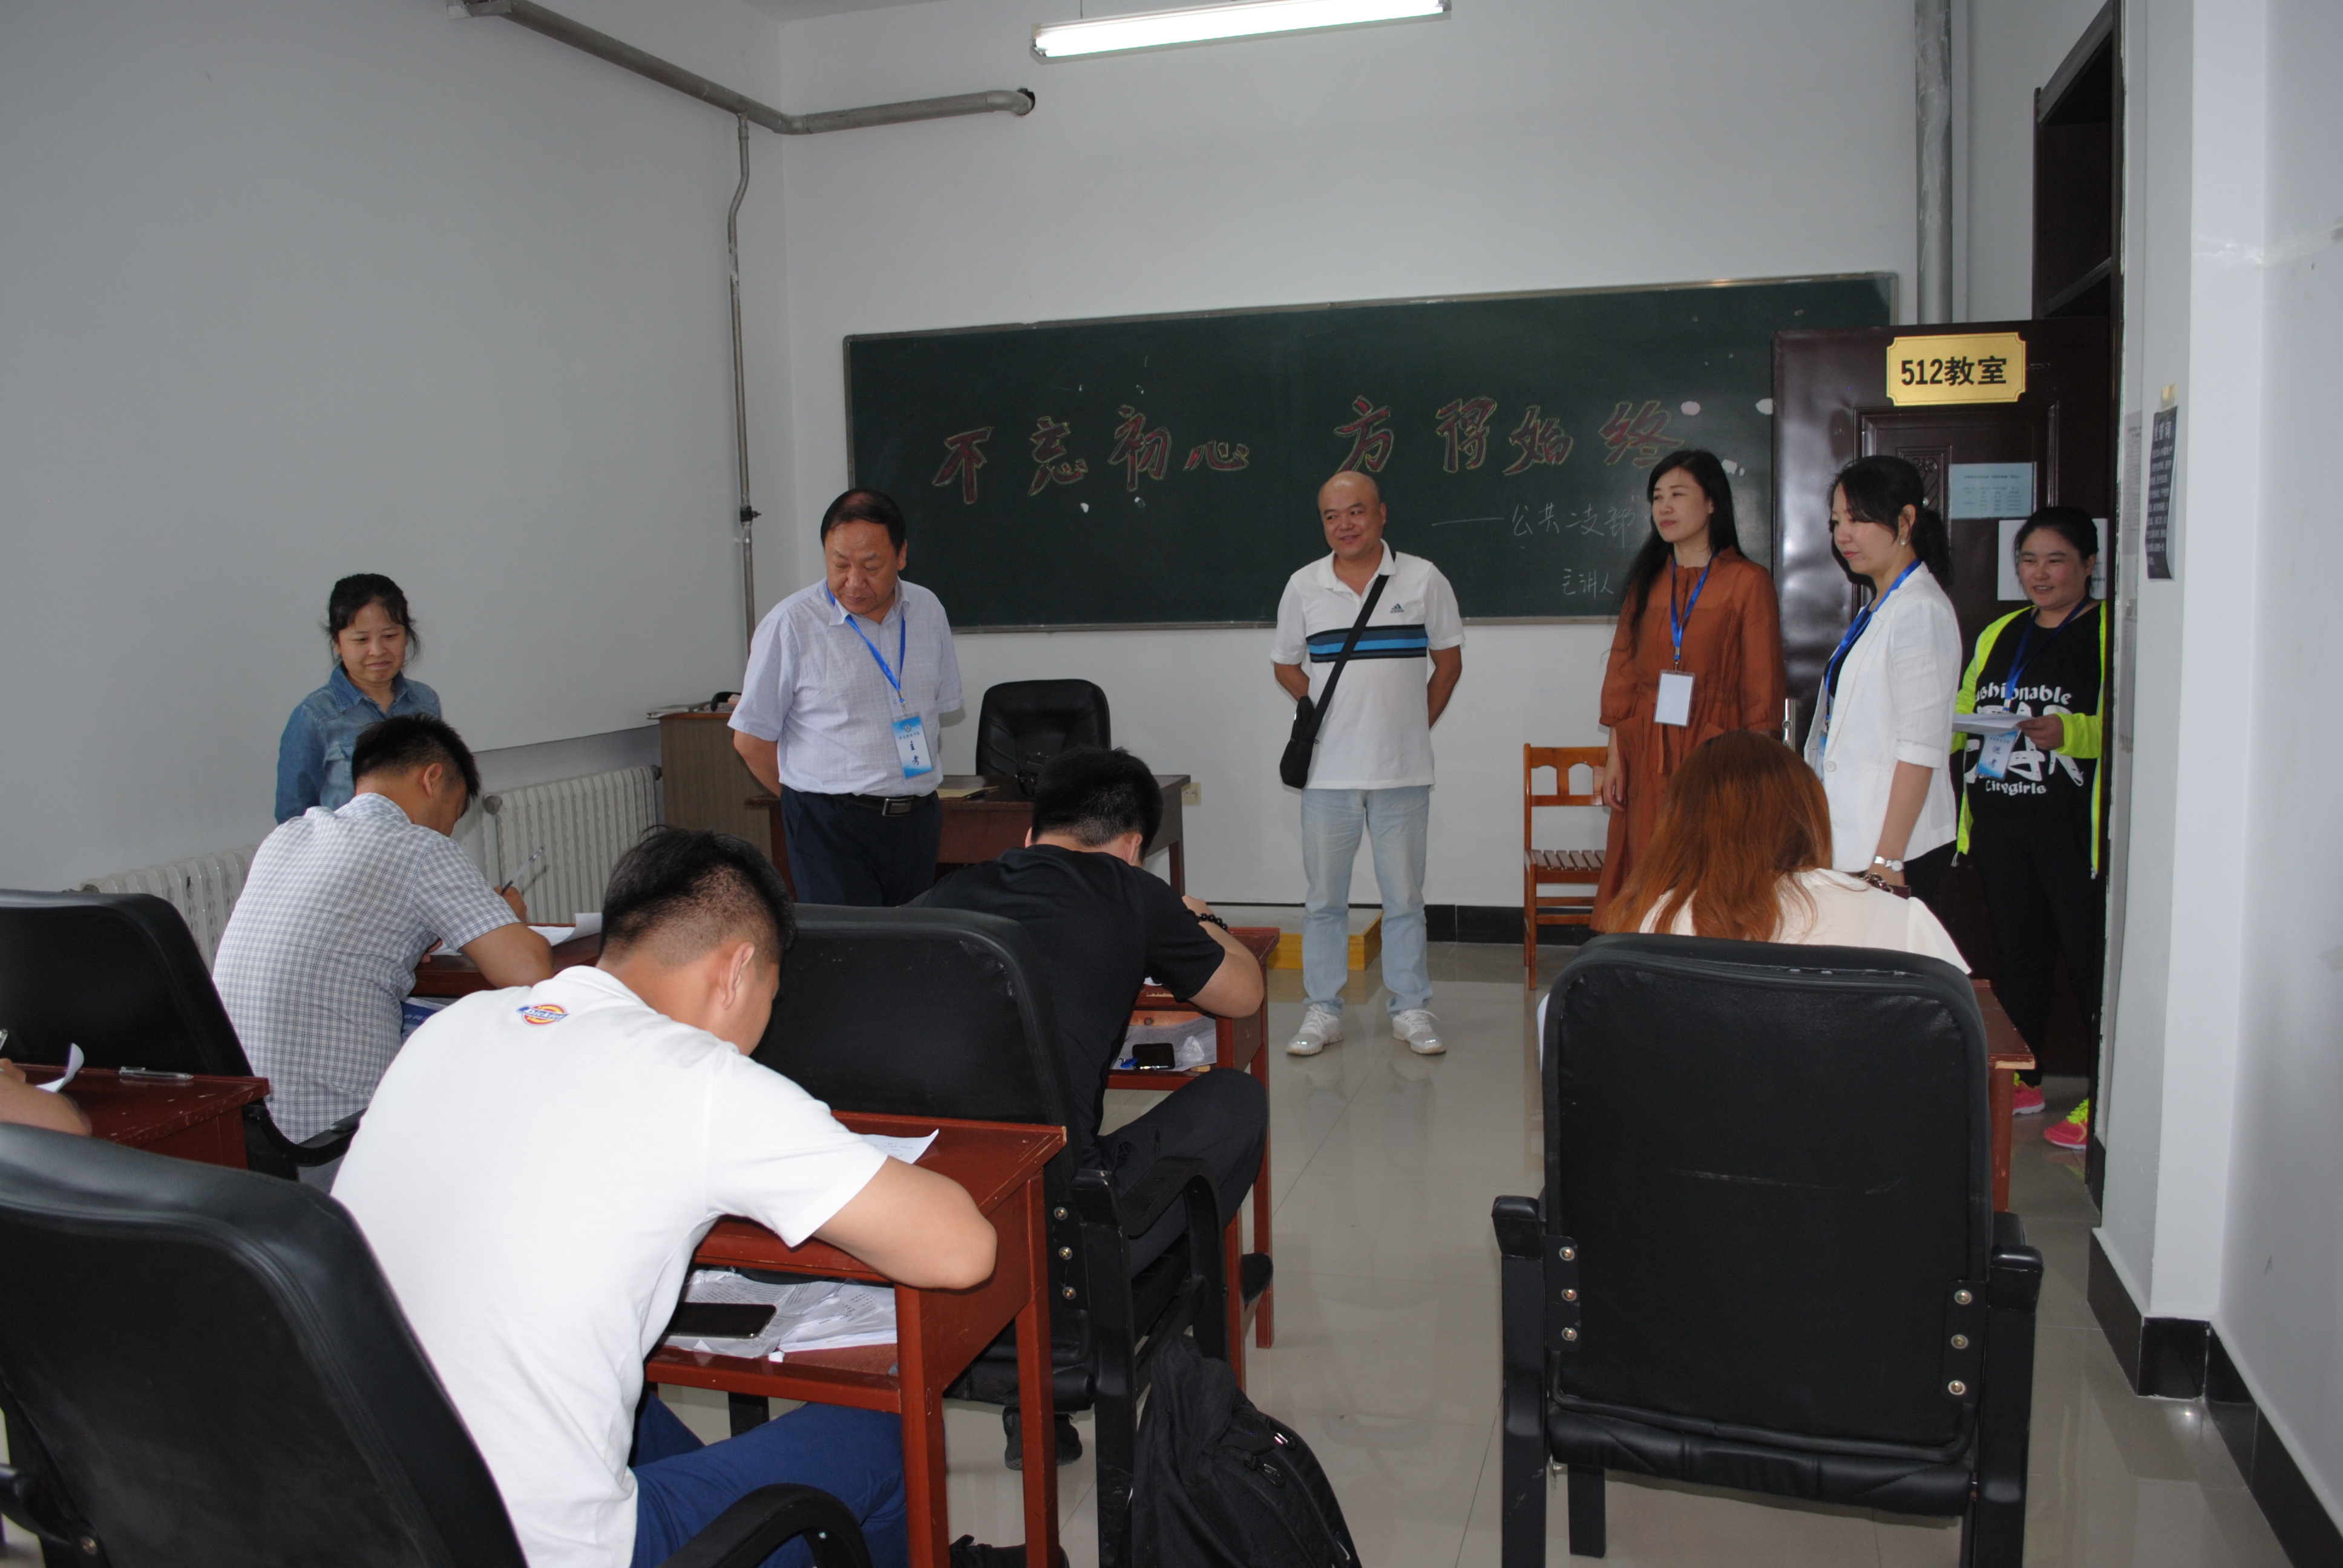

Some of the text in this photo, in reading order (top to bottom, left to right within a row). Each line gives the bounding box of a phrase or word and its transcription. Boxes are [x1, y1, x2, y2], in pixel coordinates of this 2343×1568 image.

[1901, 355, 2007, 386] 512教室
[933, 396, 1685, 505] 不忘初心 方得始终
[1562, 569, 1614, 599] 主讲人
